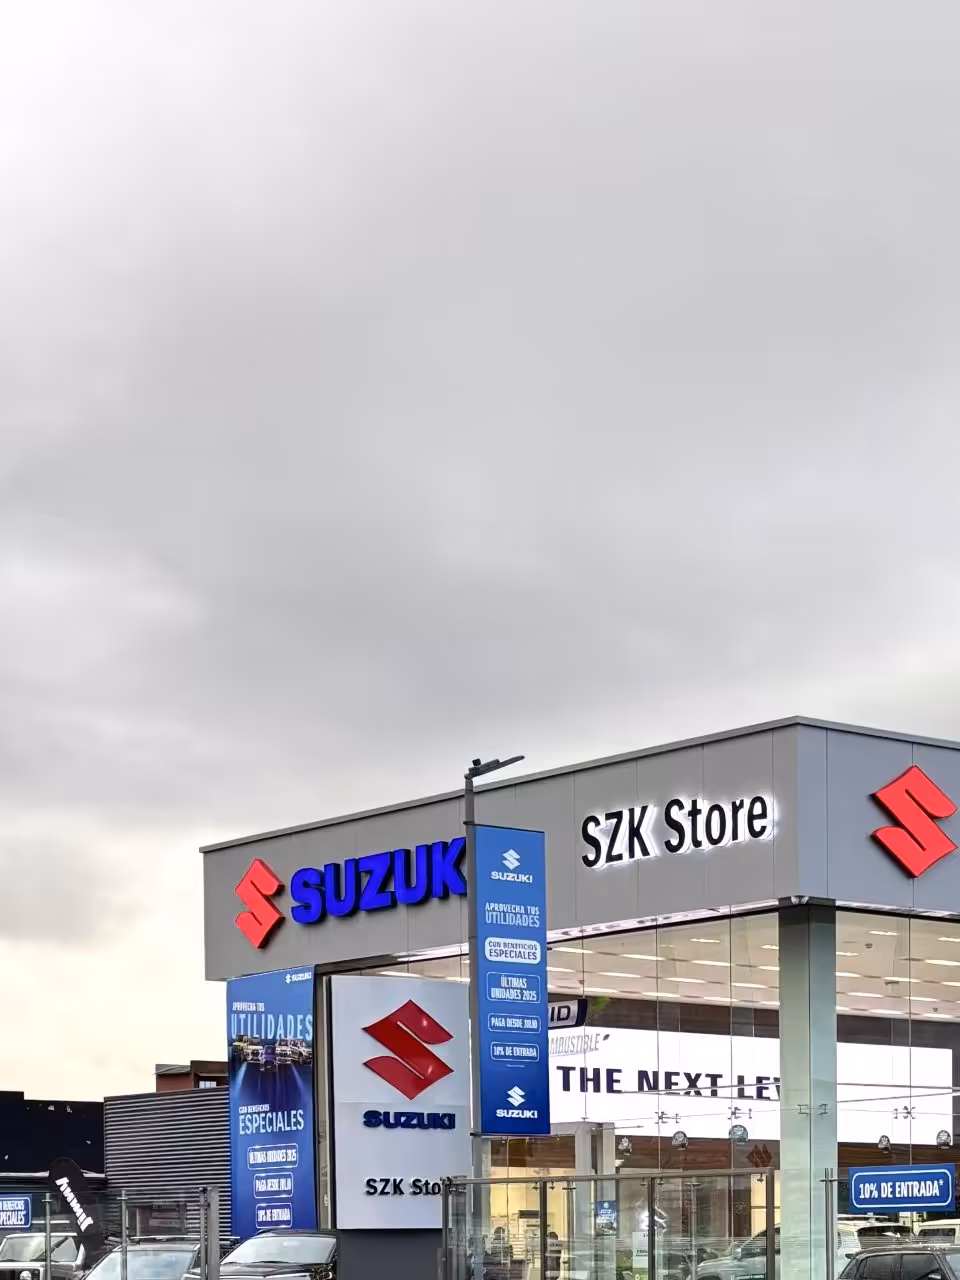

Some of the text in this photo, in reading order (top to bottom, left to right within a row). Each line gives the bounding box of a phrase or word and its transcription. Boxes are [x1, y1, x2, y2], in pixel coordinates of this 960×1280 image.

[582, 796, 768, 868] SZK Store
[291, 837, 467, 924] SUZUK
[491, 871, 533, 883] SUZUKI
[486, 902, 539, 915] APROVECHA TUS
[486, 912, 540, 928] UTILIDADES
[488, 940, 538, 951] CON BENEFICIOS
[489, 948, 537, 960] ESPECIALES
[500, 974, 526, 988] ÚLTIMAS
[491, 988, 536, 1001] UNIDADES 2025
[231, 1013, 312, 1041] UTILIDADES
[491, 1017, 505, 1028] PAGA
[506, 1018, 522, 1028] DESDE
[506, 1047, 512, 1056] DE
[514, 1047, 537, 1057] ENTRADA
[556, 1066, 622, 1093] THE
[638, 1070, 723, 1097] NEXT
[363, 1110, 456, 1129] SUZUKI
[496, 1108, 538, 1118] SUZUKI
[239, 1110, 304, 1134] ESPECIALES
[365, 1178, 442, 1196] SZK Sto
[859, 1182, 878, 1198] 10%
[881, 1182, 893, 1198] DE
